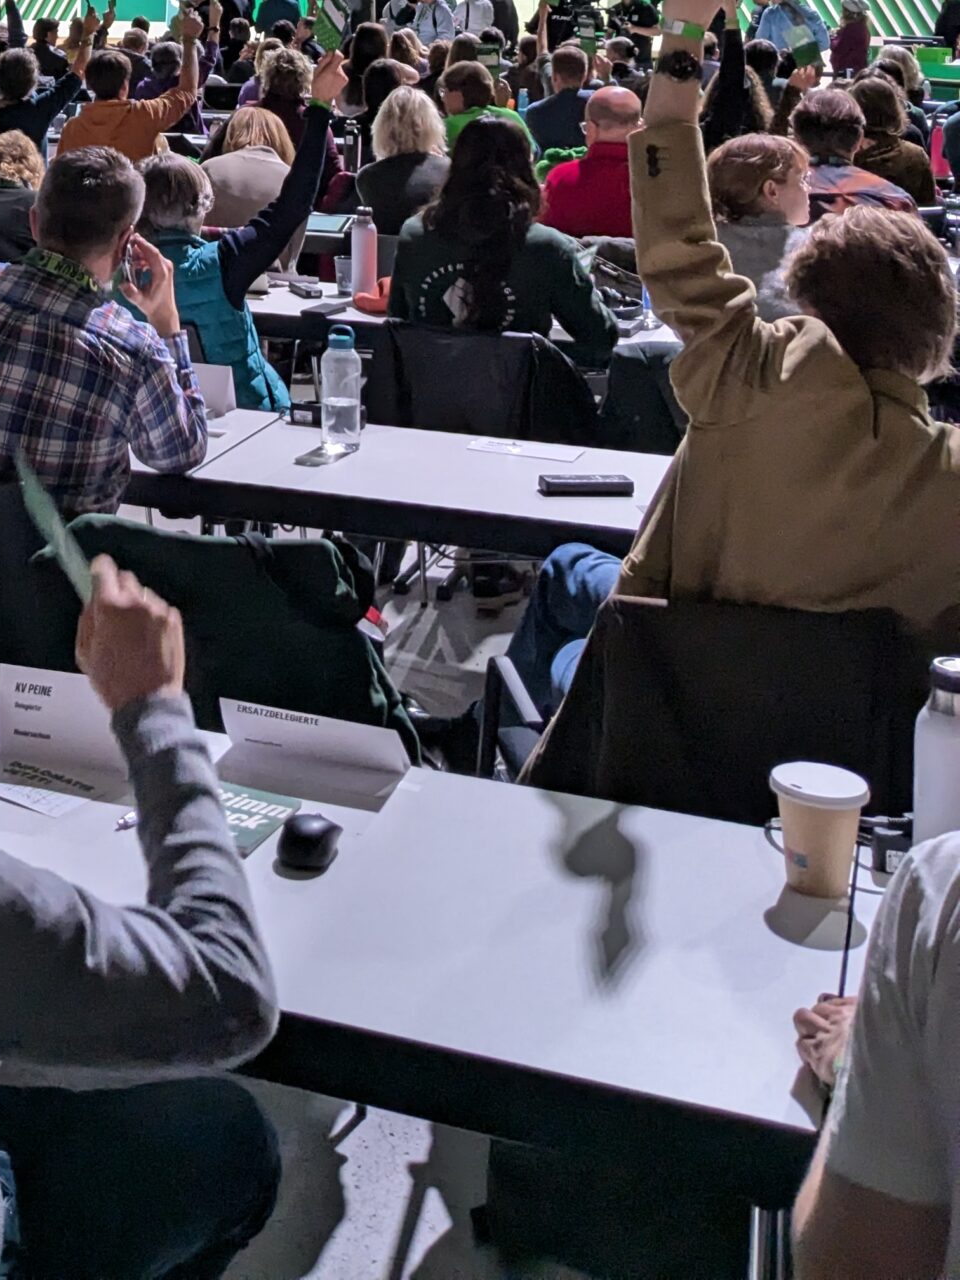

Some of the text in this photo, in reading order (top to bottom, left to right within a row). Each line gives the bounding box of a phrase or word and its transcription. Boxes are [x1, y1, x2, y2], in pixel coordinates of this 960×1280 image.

[15, 681, 53, 697] KV PEINE
[236, 704, 320, 727] ERSATZDELEGIERTE
